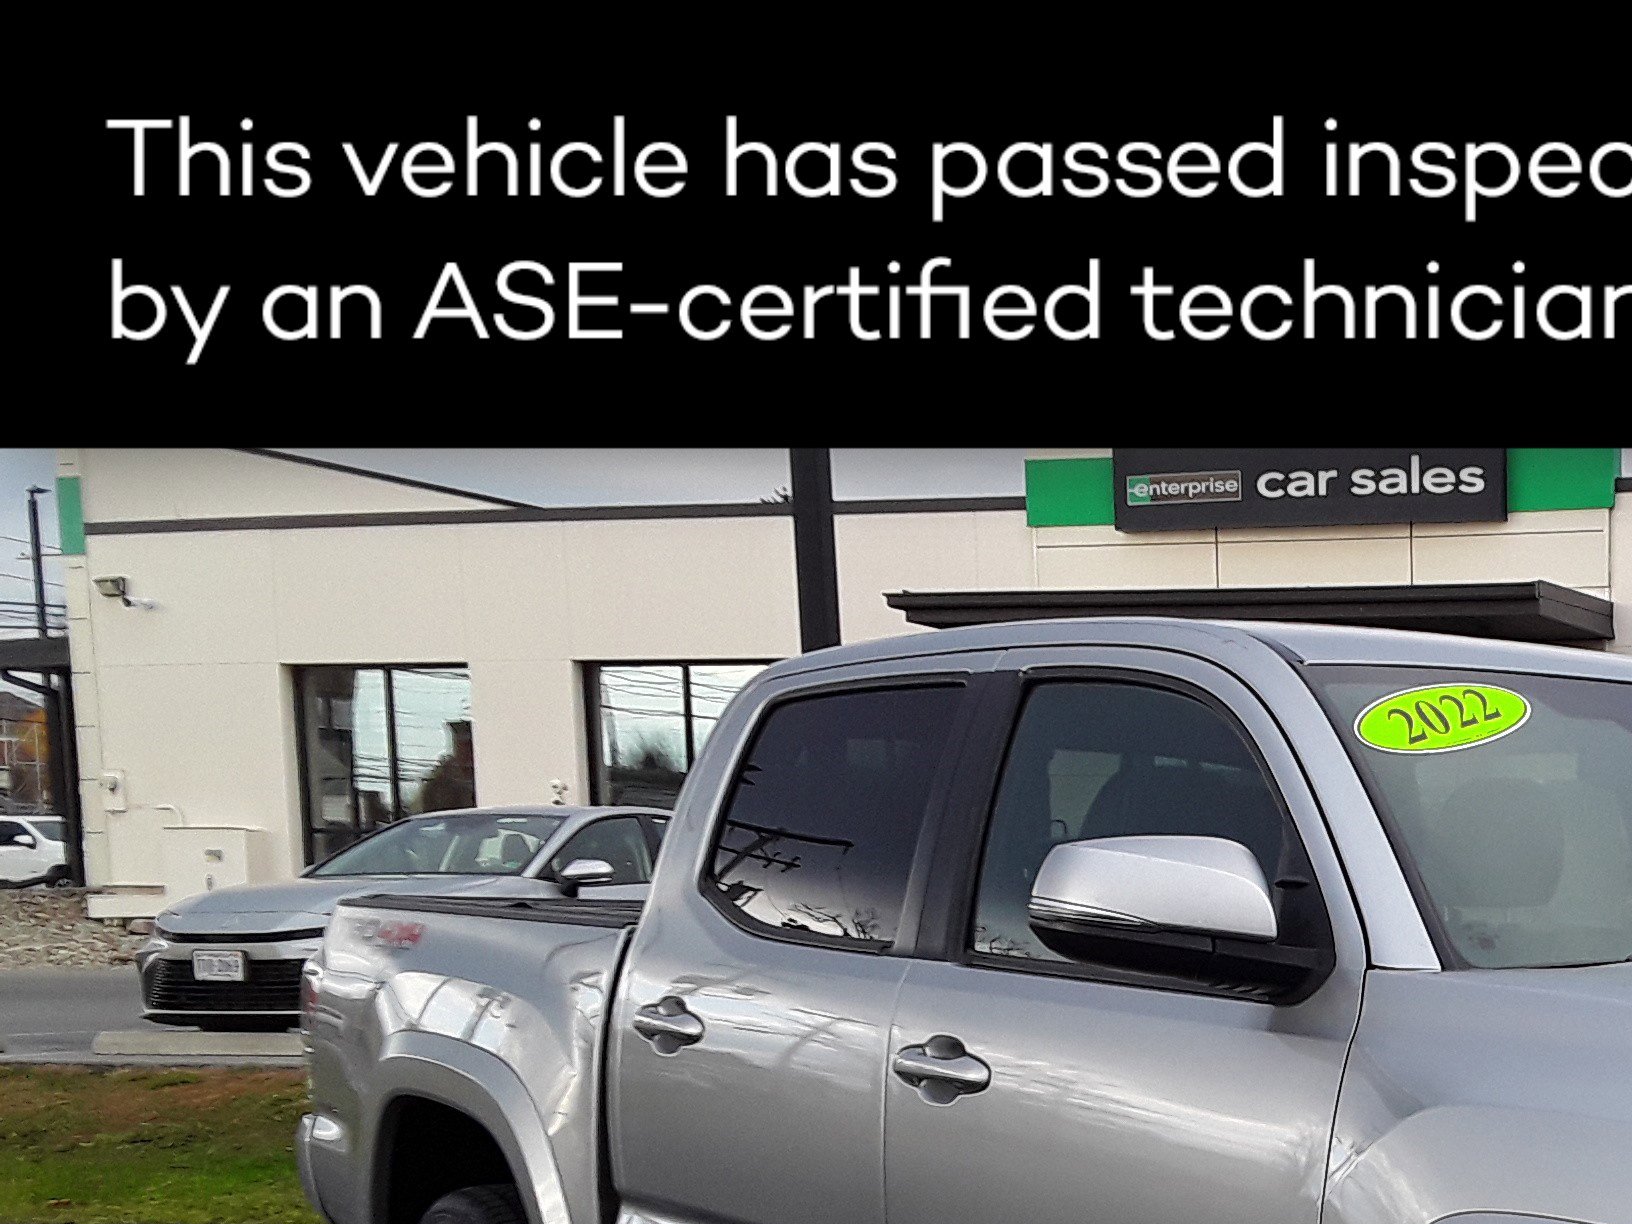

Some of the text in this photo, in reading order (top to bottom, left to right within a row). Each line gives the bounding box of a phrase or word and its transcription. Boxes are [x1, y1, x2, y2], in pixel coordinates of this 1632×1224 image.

[1132, 453, 1486, 499] enterprise car sales
[1387, 688, 1503, 745] 2022
